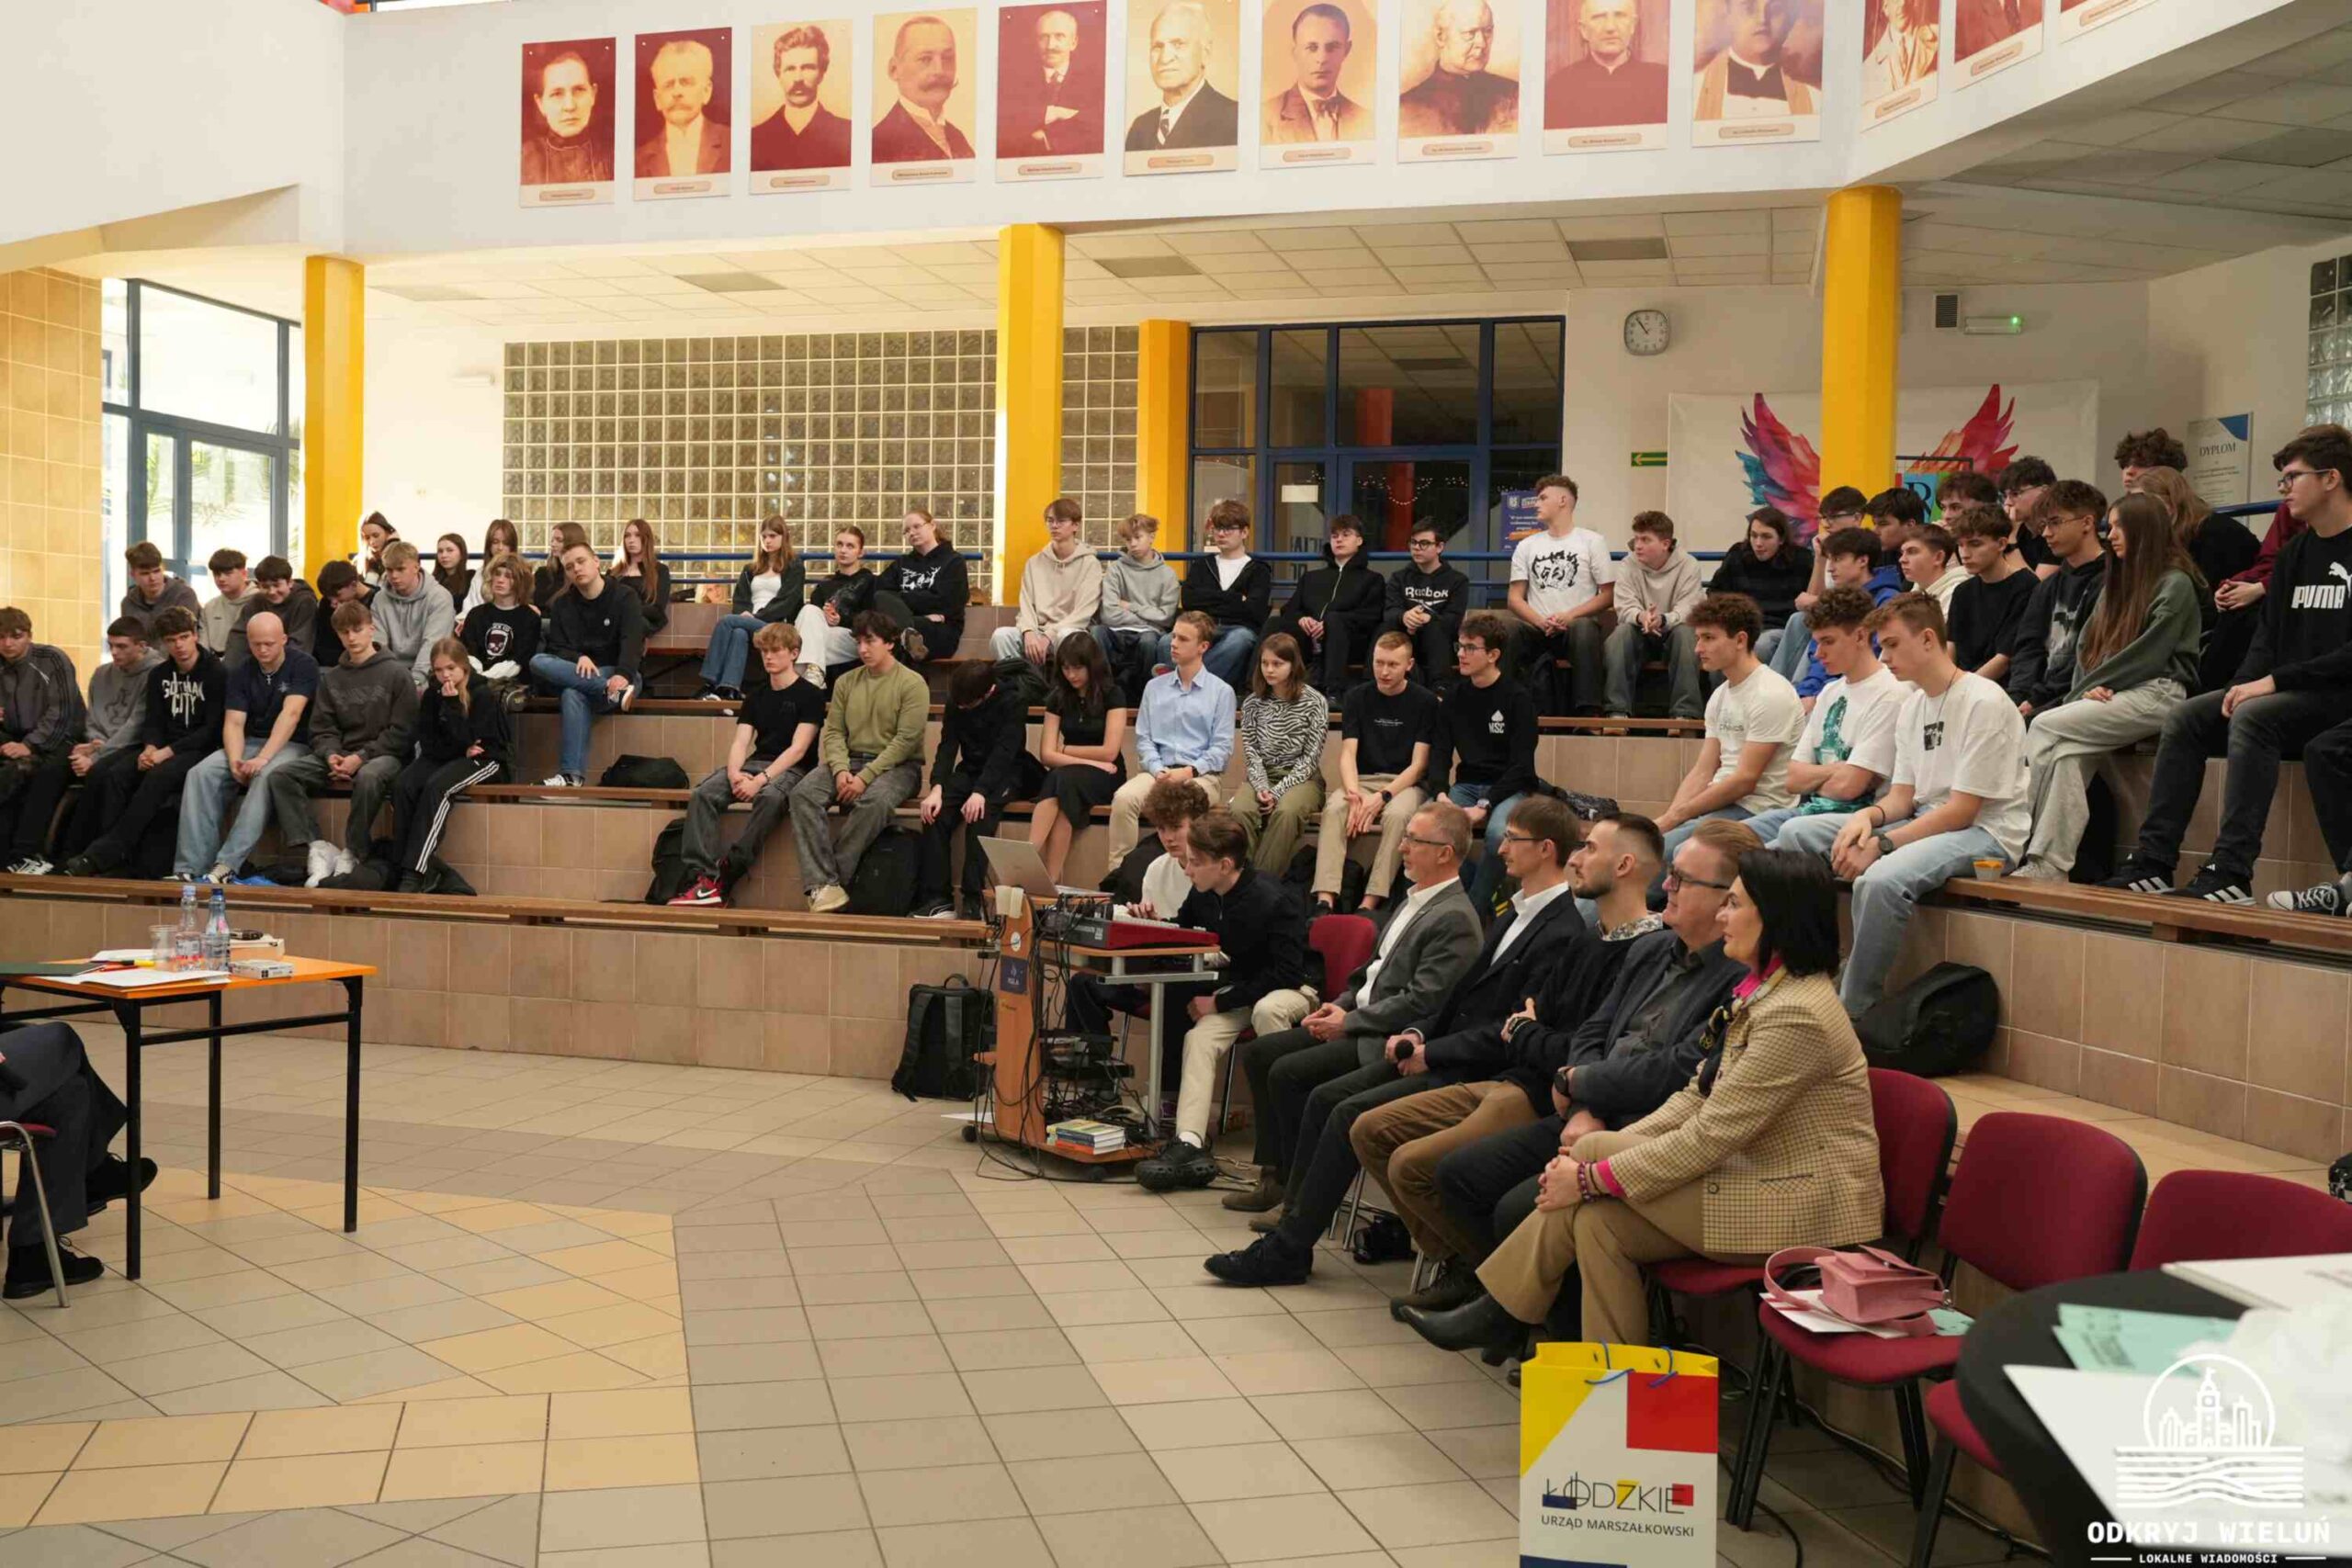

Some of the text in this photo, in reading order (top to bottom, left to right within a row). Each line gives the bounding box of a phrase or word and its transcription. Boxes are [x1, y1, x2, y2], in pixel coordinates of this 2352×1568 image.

[2199, 443, 2236, 457] DYPLOM
[2291, 585, 2346, 609] PUMA
[172, 694, 196, 728] CITY
[1542, 1515, 1694, 1537] URZĄD MARSZAŁKOWSKI
